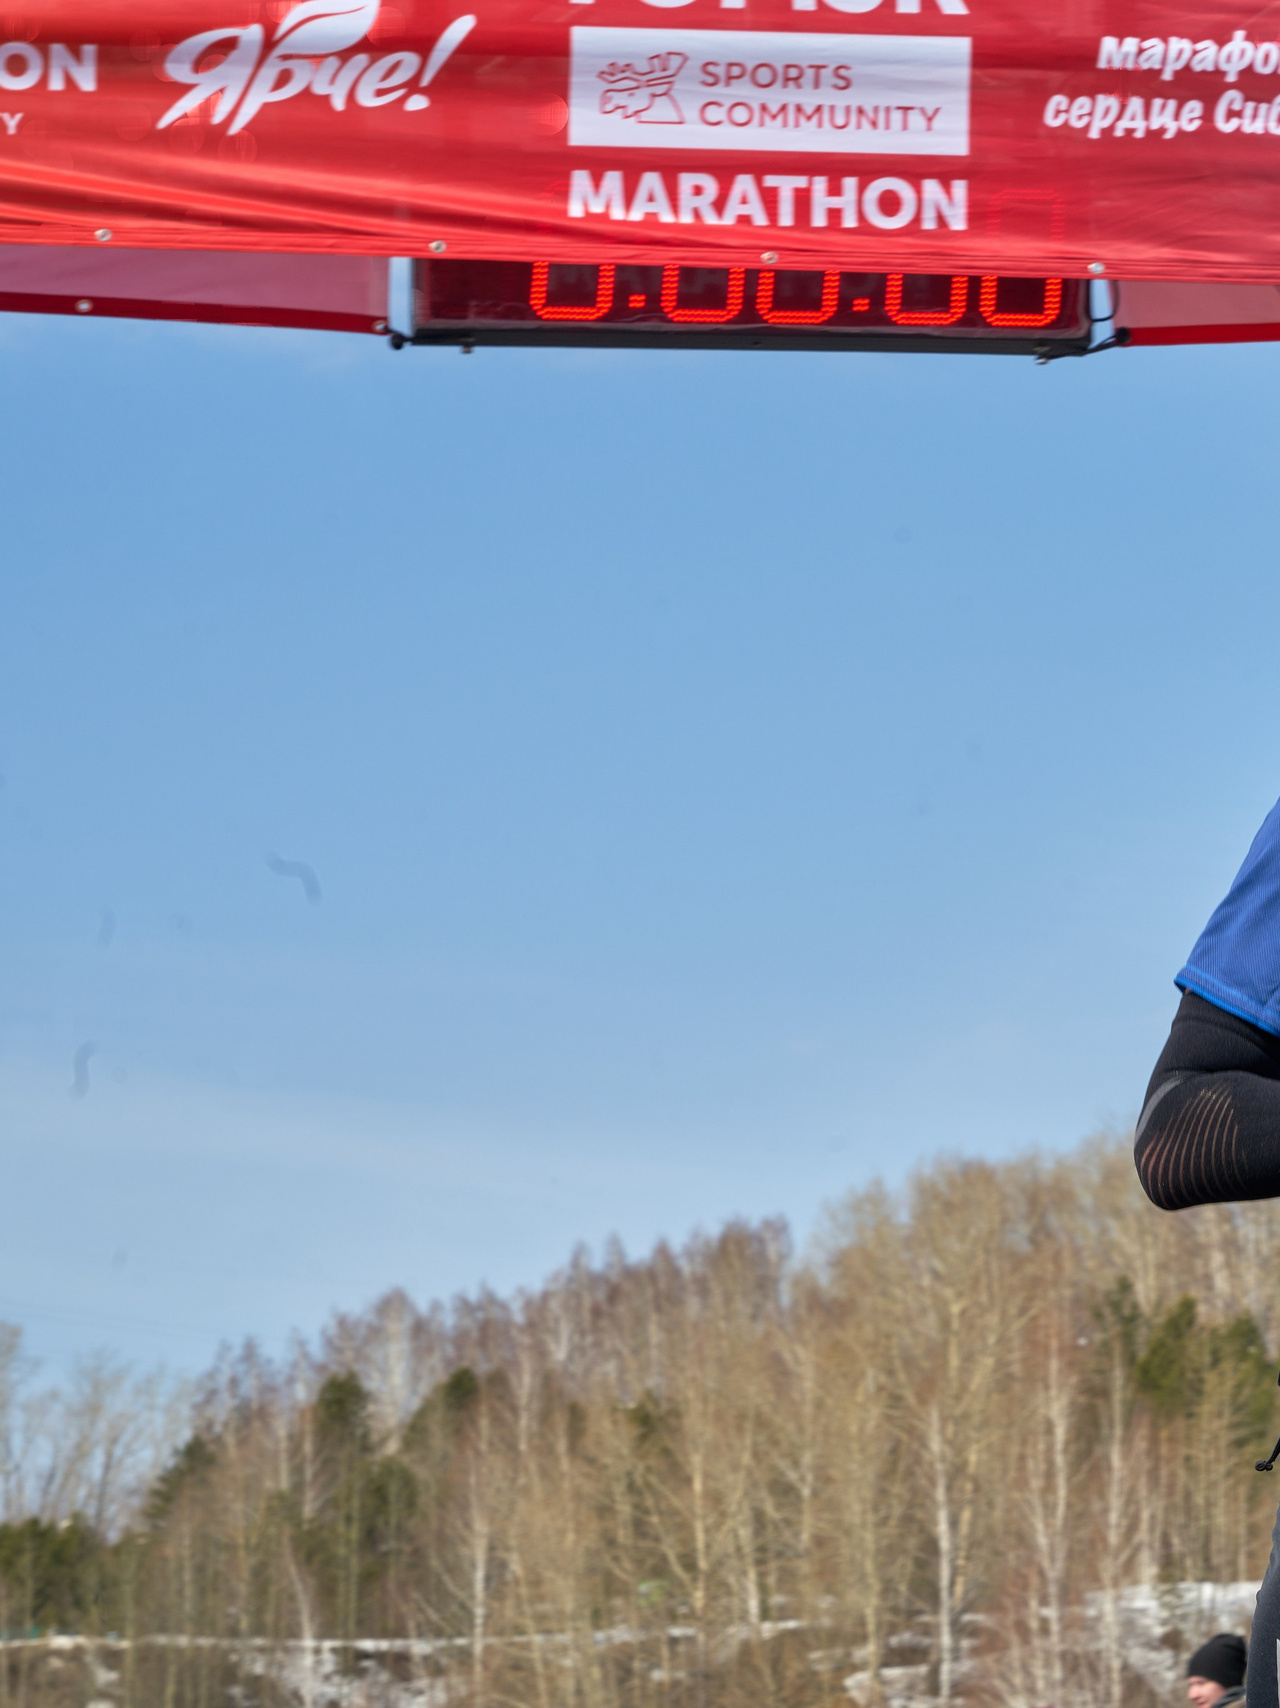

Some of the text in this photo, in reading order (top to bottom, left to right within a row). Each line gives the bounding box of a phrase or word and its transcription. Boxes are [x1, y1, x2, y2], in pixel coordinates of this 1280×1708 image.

[699, 60, 853, 91] SPORTS
[699, 100, 941, 131] COMMUNITY
[1043, 93, 1204, 140] сердце
[566, 169, 968, 231] MARATHON
